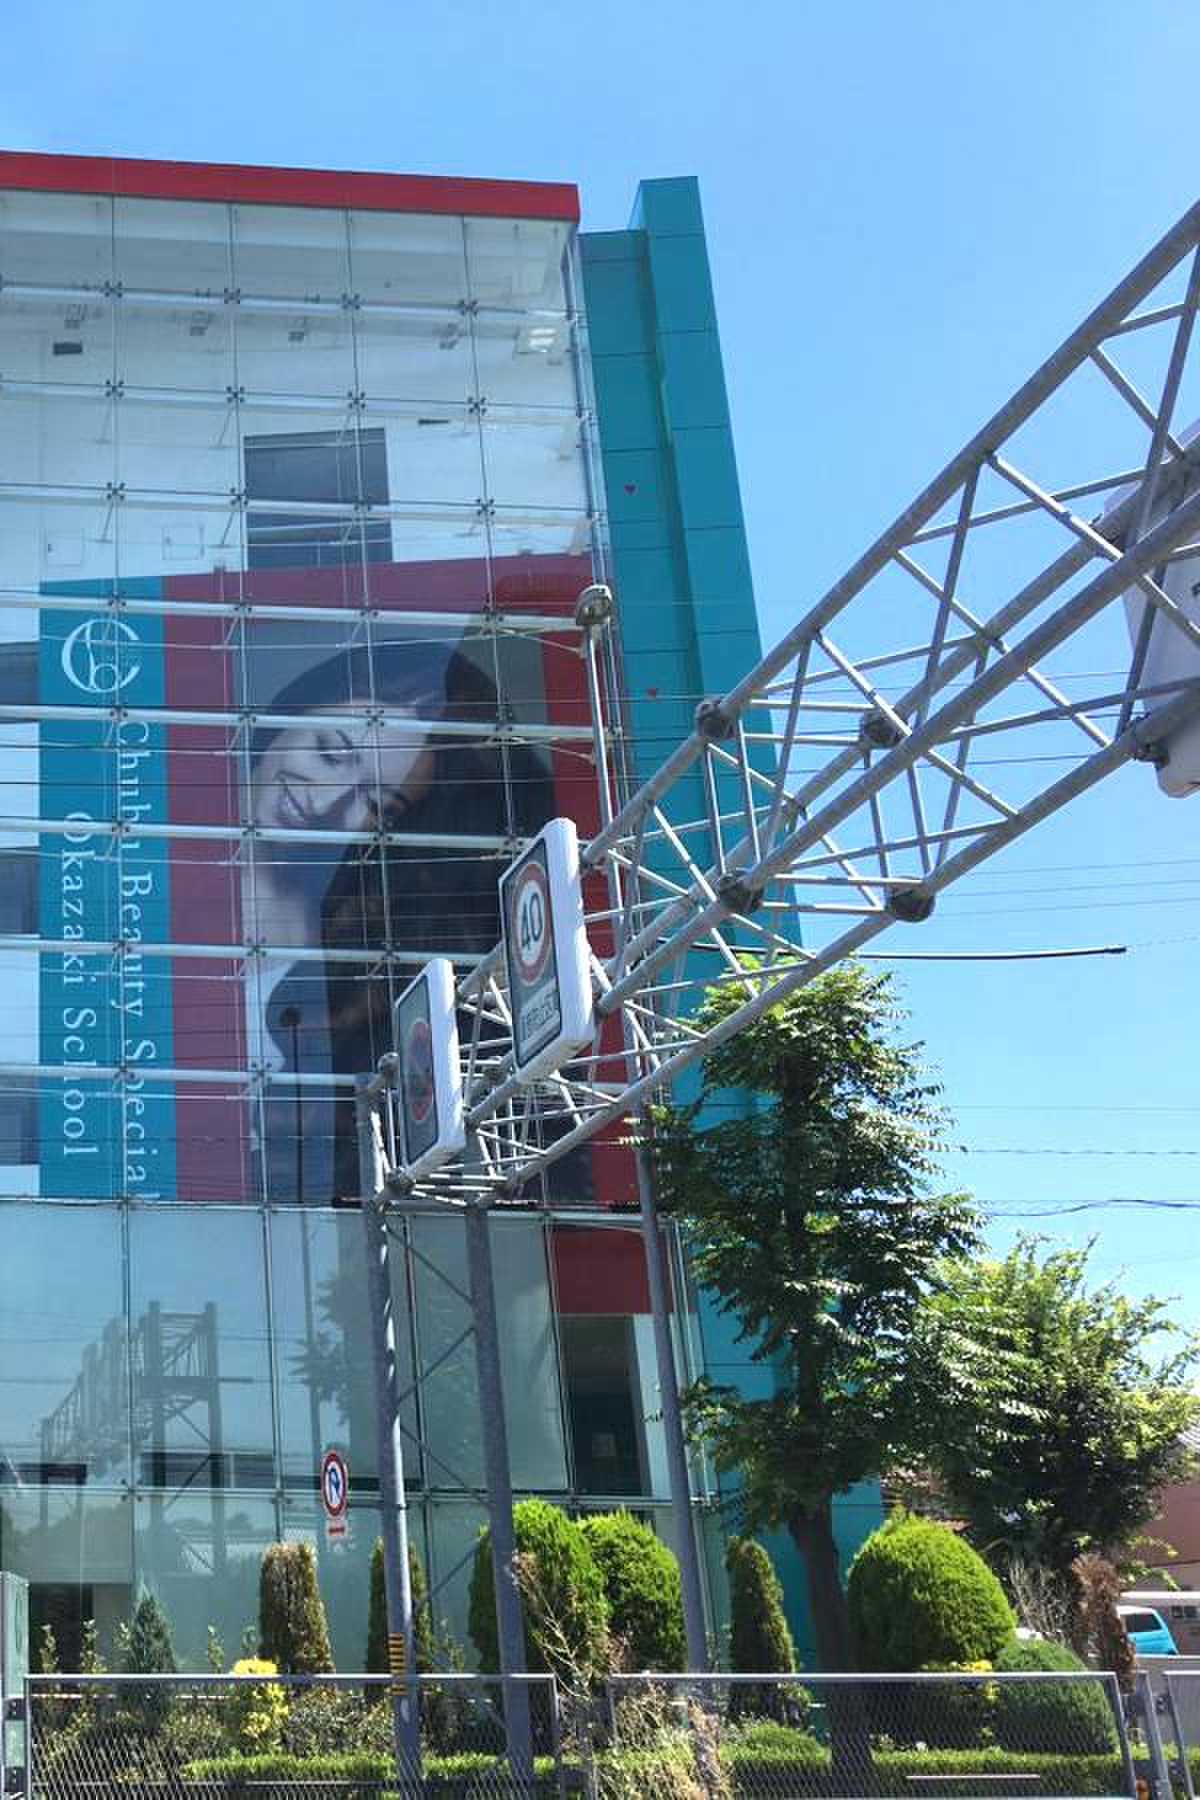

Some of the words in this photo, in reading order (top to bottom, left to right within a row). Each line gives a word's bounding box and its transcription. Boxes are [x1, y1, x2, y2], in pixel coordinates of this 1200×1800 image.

[62, 811, 97, 985] Okazaki
[110, 871, 153, 1017] Beauty
[520, 892, 543, 951] 40
[63, 1007, 99, 1155] School
